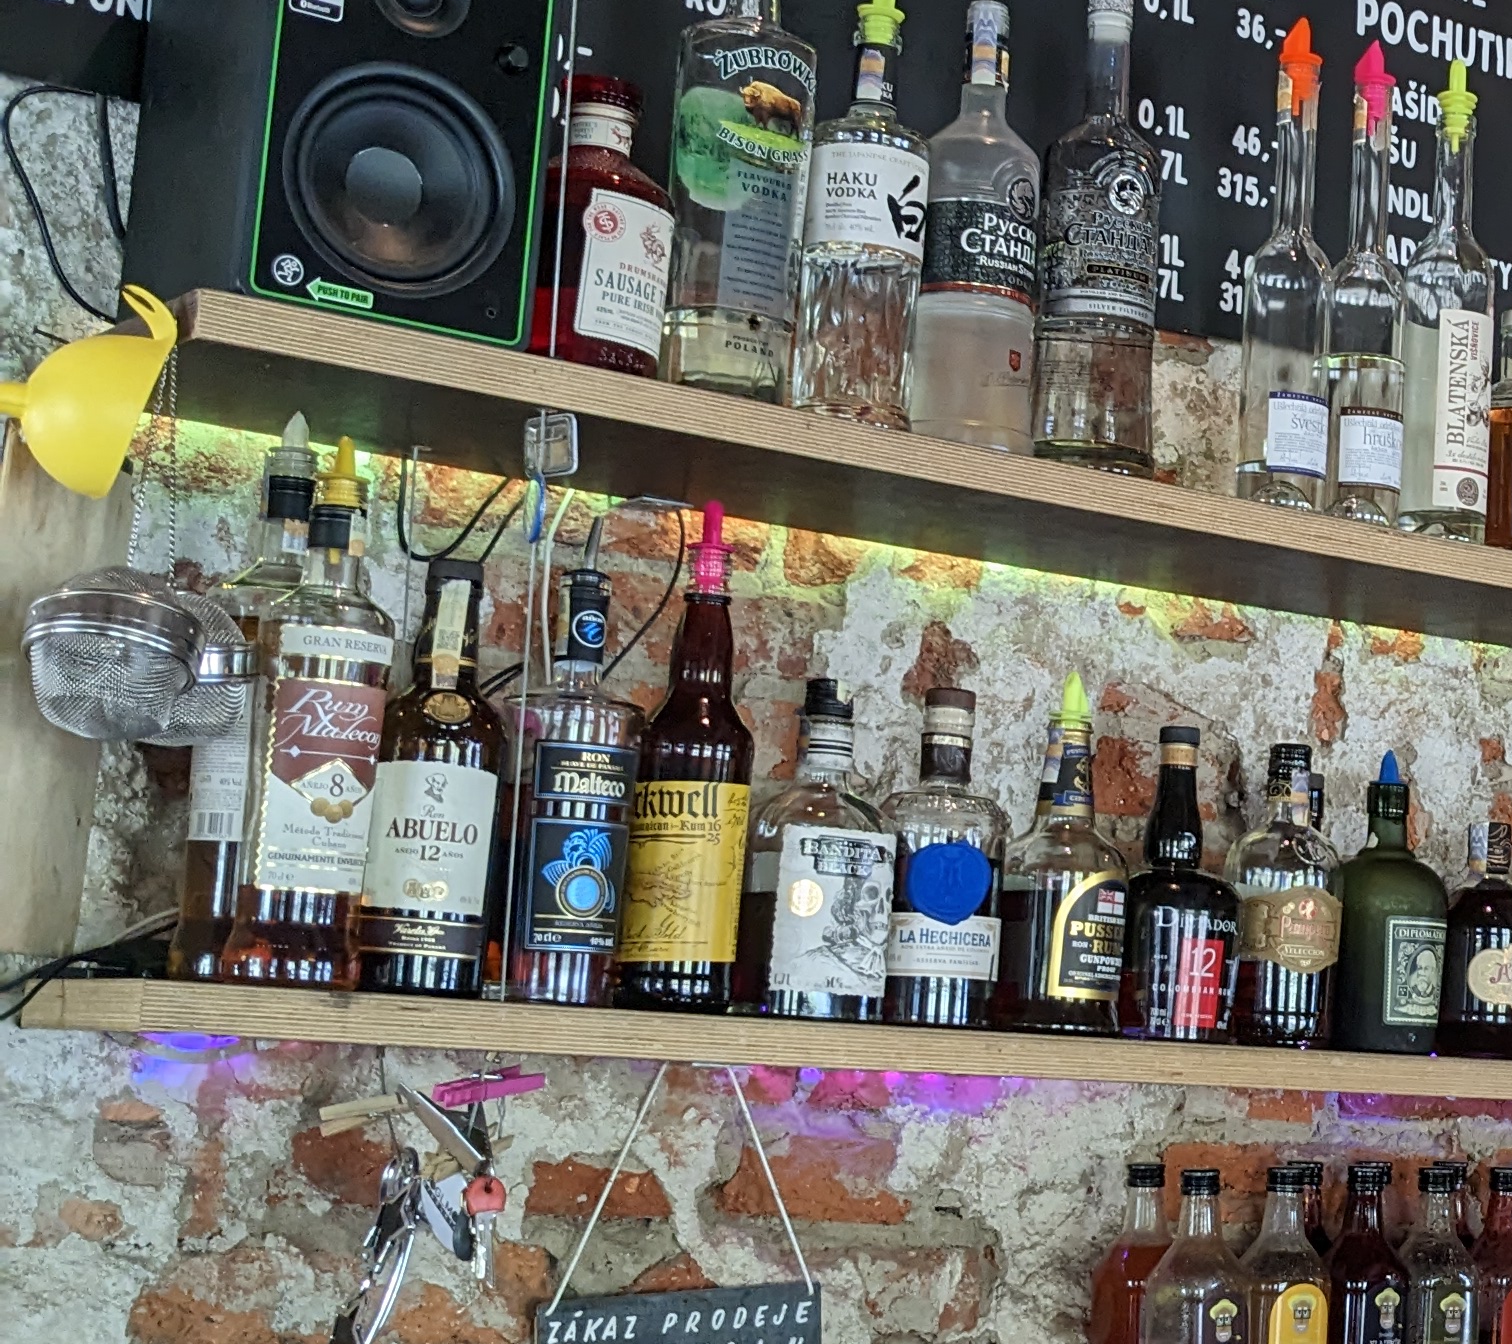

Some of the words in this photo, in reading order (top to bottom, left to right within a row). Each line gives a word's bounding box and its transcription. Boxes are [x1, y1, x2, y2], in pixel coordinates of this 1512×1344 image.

[826, 171, 878, 187] HAKU
[826, 185, 877, 201] VODKA
[594, 268, 658, 302] SAUSAGE
[1445, 318, 1470, 447] BLATENSKÁ
[302, 634, 341, 652] GRAN
[385, 818, 478, 847] ABUELO
[419, 843, 441, 863] 12
[900, 929, 915, 945] LA
[1188, 946, 1215, 978] 12
[548, 1311, 637, 1344] ZÁKAZ
[662, 1301, 812, 1336] PRODEJE
